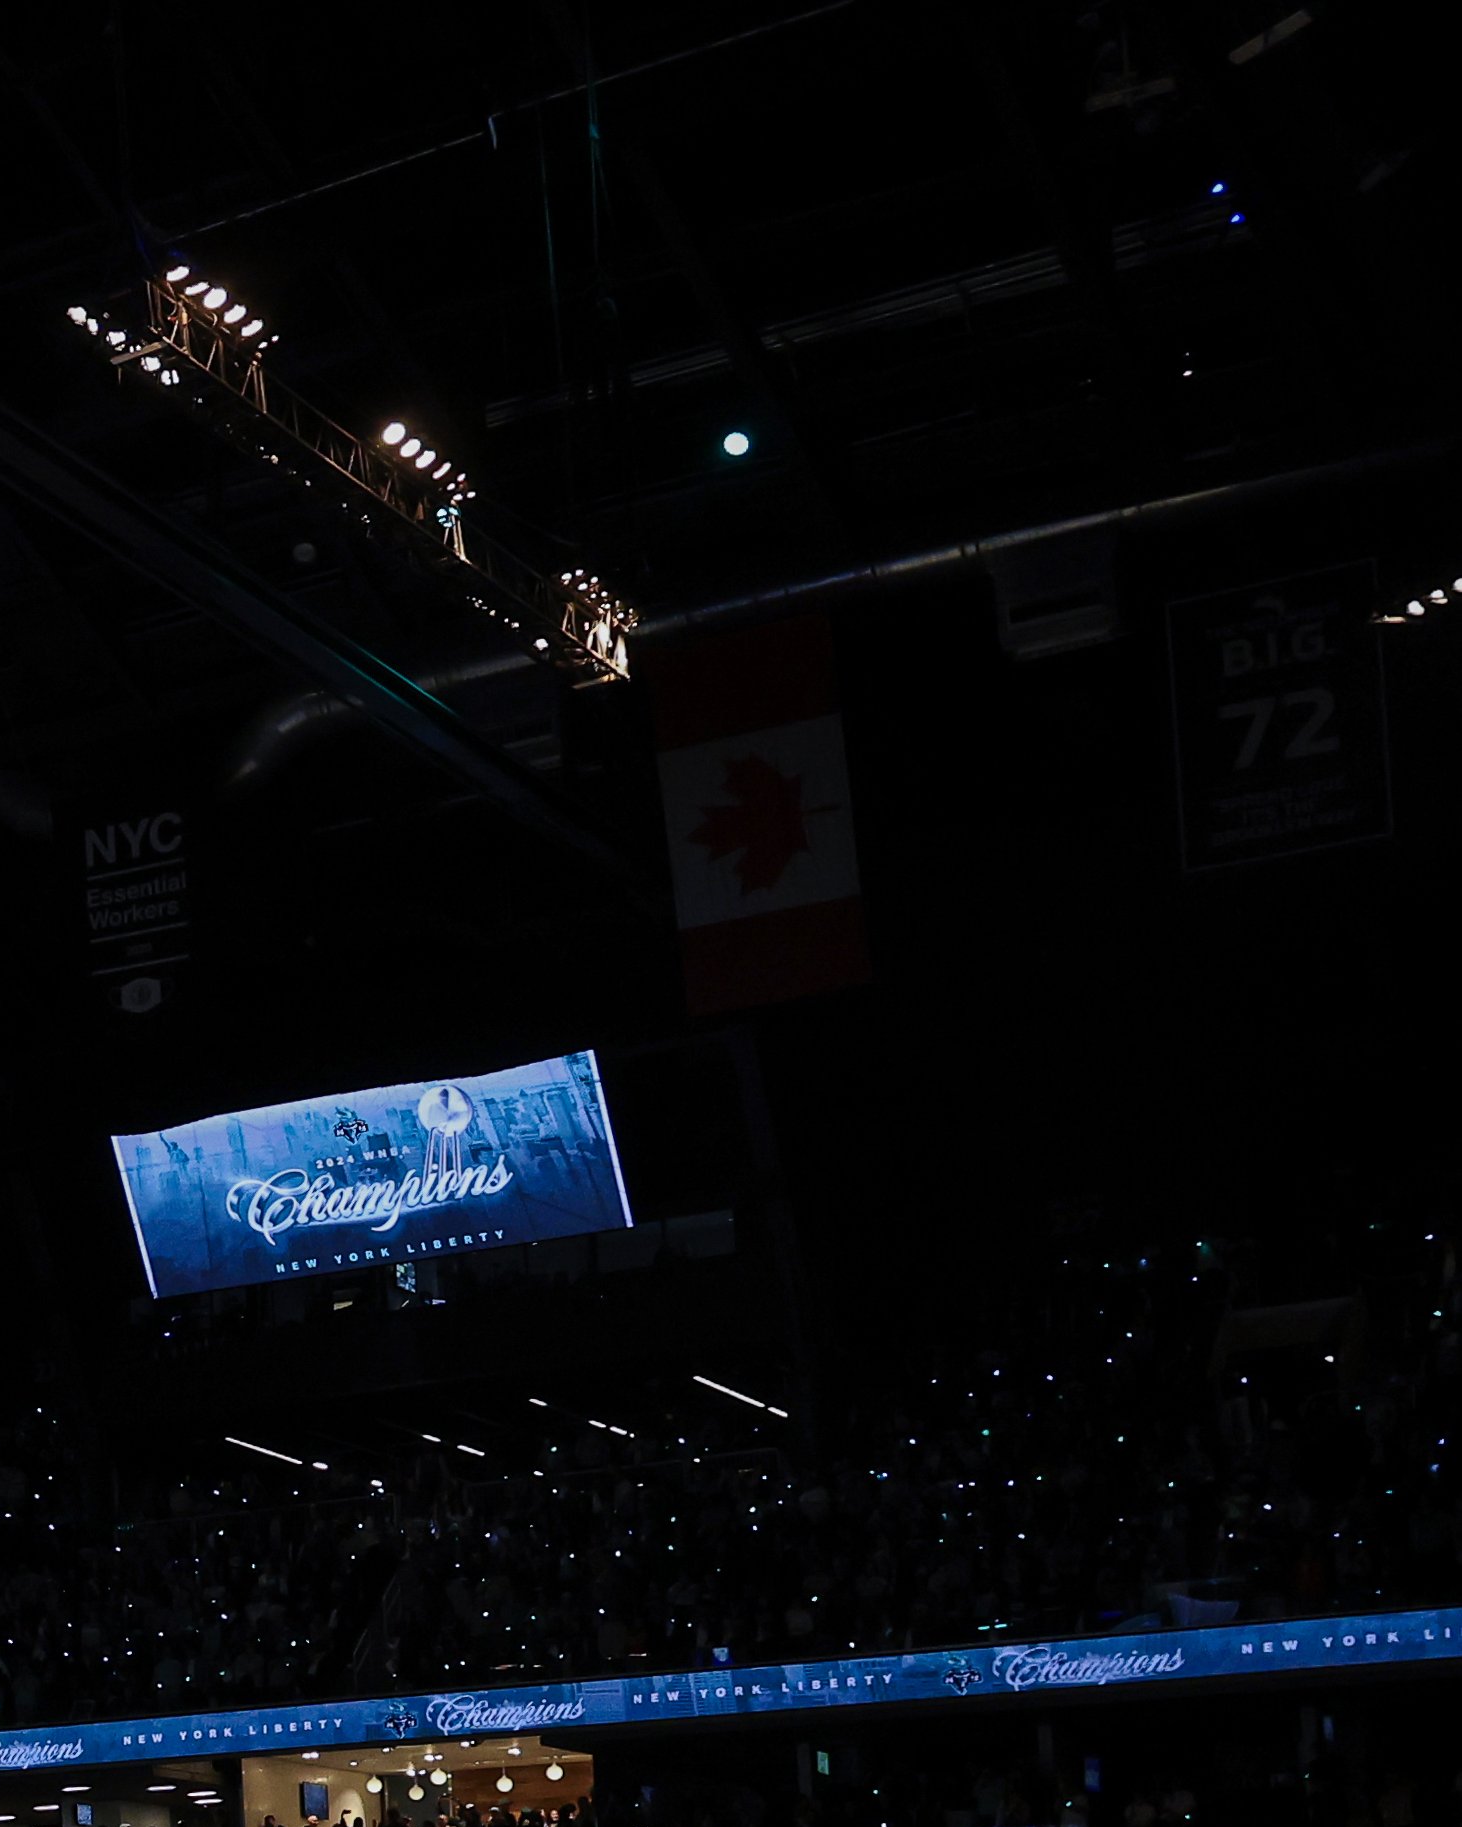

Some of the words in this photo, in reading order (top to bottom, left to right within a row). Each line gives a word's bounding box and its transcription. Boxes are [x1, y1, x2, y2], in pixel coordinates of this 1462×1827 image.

[1216, 687, 1342, 770] 72
[84, 812, 182, 868] NYC
[87, 871, 187, 908] Essential
[89, 900, 180, 930] Workers
[316, 1154, 355, 1170] 2024
[363, 1145, 412, 1162] WNBA
[226, 1154, 513, 1246] Champions
[276, 1257, 320, 1274] NEW
[334, 1246, 391, 1266] YORK
[406, 1228, 506, 1255] LIBERTY
[123, 1732, 165, 1746] NEW
[179, 1727, 234, 1743] YORK
[248, 1718, 345, 1737] LIBERTY
[425, 1695, 586, 1736] Champions
[633, 1690, 681, 1704] NEW
[699, 1683, 763, 1699] YORK
[781, 1673, 896, 1694] LIBERTY
[992, 1646, 1187, 1692] Champions
[1241, 1640, 1300, 1655] NEW
[1322, 1631, 1401, 1649] YORK
